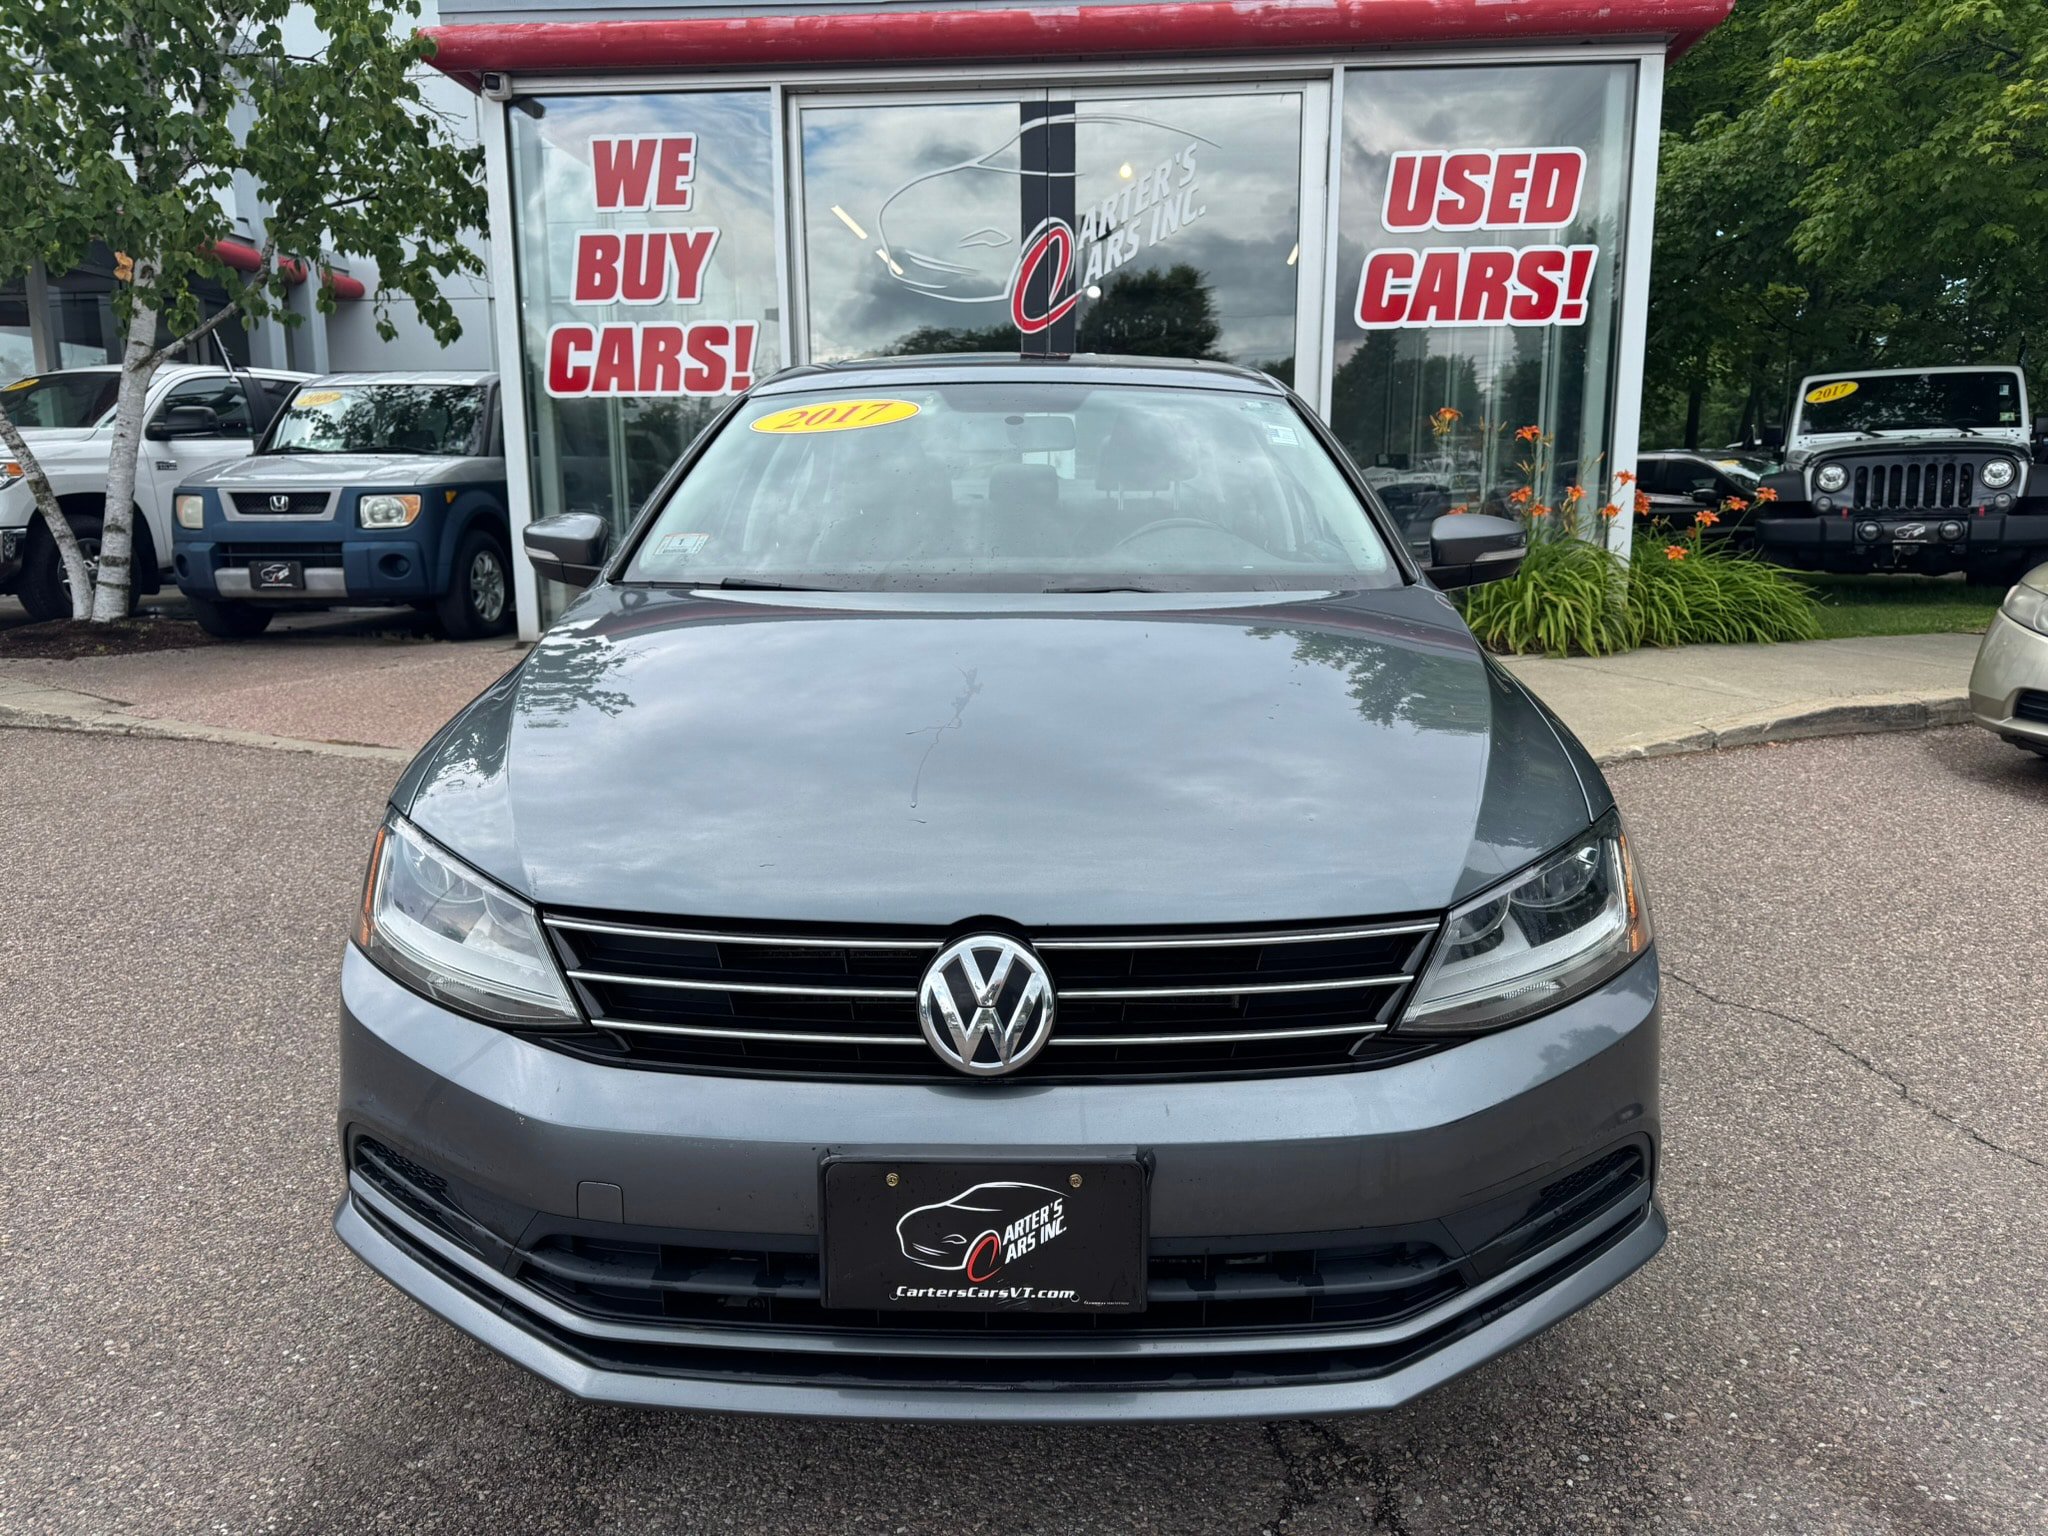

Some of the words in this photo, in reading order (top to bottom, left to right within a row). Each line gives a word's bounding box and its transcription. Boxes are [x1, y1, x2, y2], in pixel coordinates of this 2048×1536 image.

[592, 137, 693, 208] WE
[1386, 152, 1582, 227] USED
[575, 231, 715, 301] BUY
[1360, 249, 1594, 324] CARS!
[548, 324, 755, 393] CARS!
[1813, 382, 1850, 402] 2017
[774, 402, 894, 430] 2017
[896, 1285, 1075, 1299] CartersCarsVT.com
